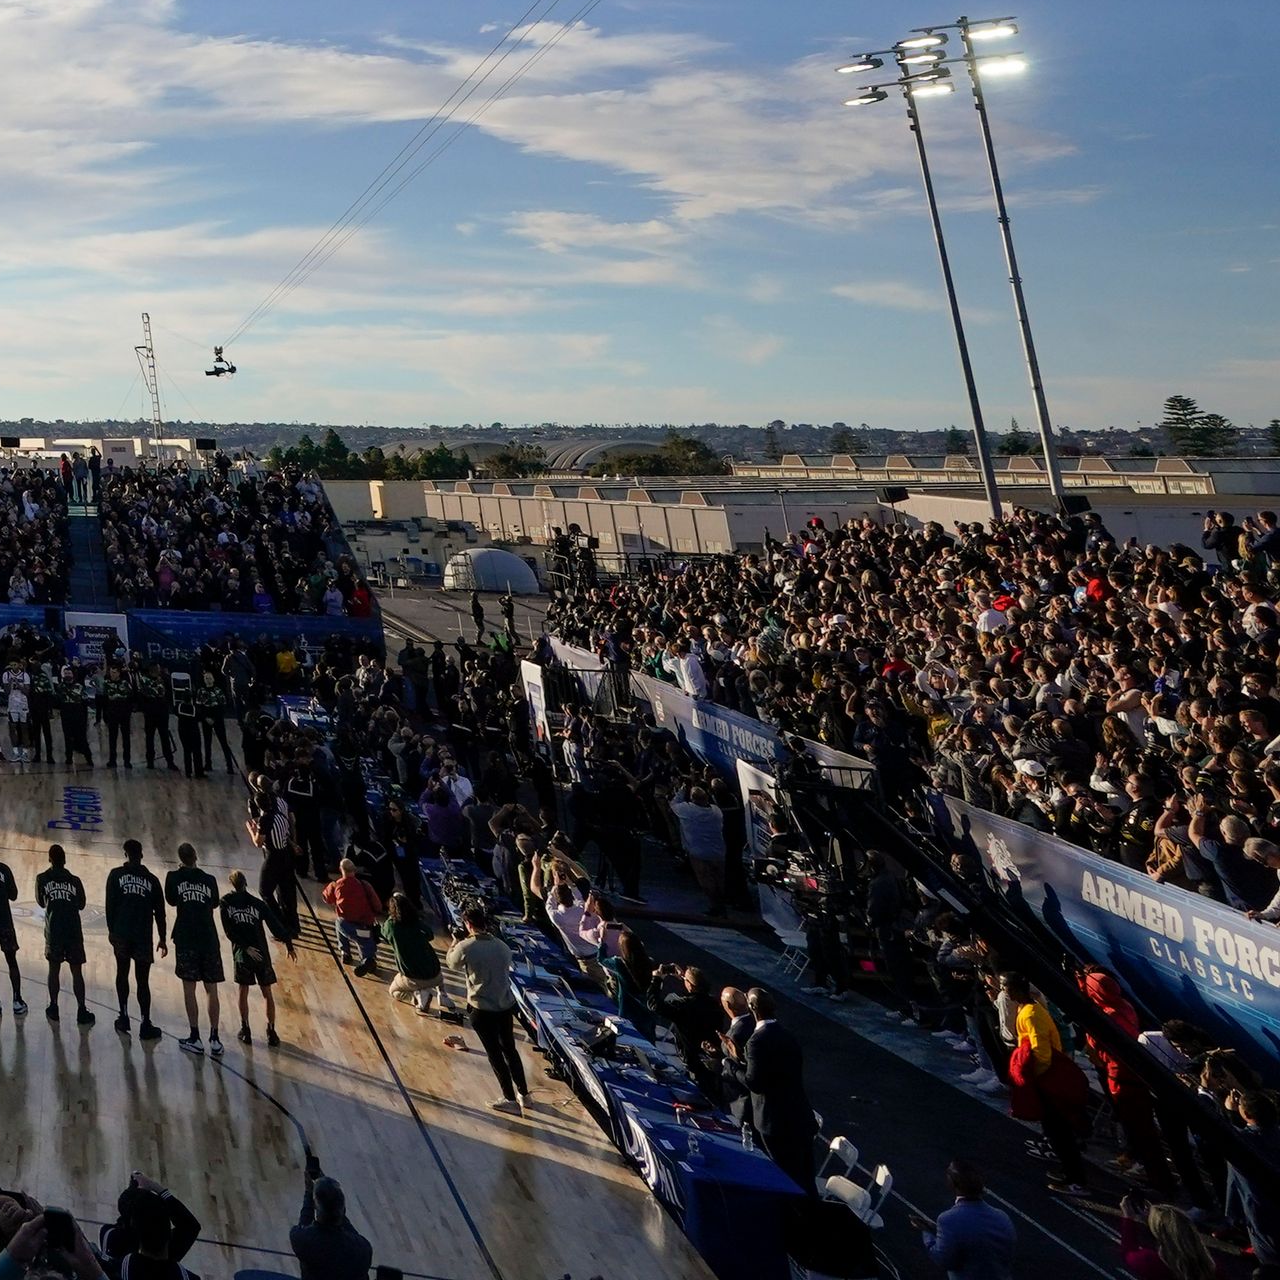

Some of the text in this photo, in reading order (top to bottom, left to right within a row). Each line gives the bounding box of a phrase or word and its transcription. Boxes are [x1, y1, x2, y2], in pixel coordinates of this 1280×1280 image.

[731, 723, 777, 759] FORCES
[47, 786, 103, 833] Peraton
[44, 880, 77, 896] MICHIGAN
[119, 873, 152, 892] MICHIGAN
[123, 883, 146, 897] STATE
[177, 880, 212, 898] MICHIGAN
[49, 889, 71, 902] STATE
[182, 889, 206, 904] STATE
[227, 905, 260, 921] MICHIGAN
[1081, 870, 1184, 944] ARMED
[233, 911, 255, 926] STATE
[1149, 936, 1255, 1002] CLASSIC
